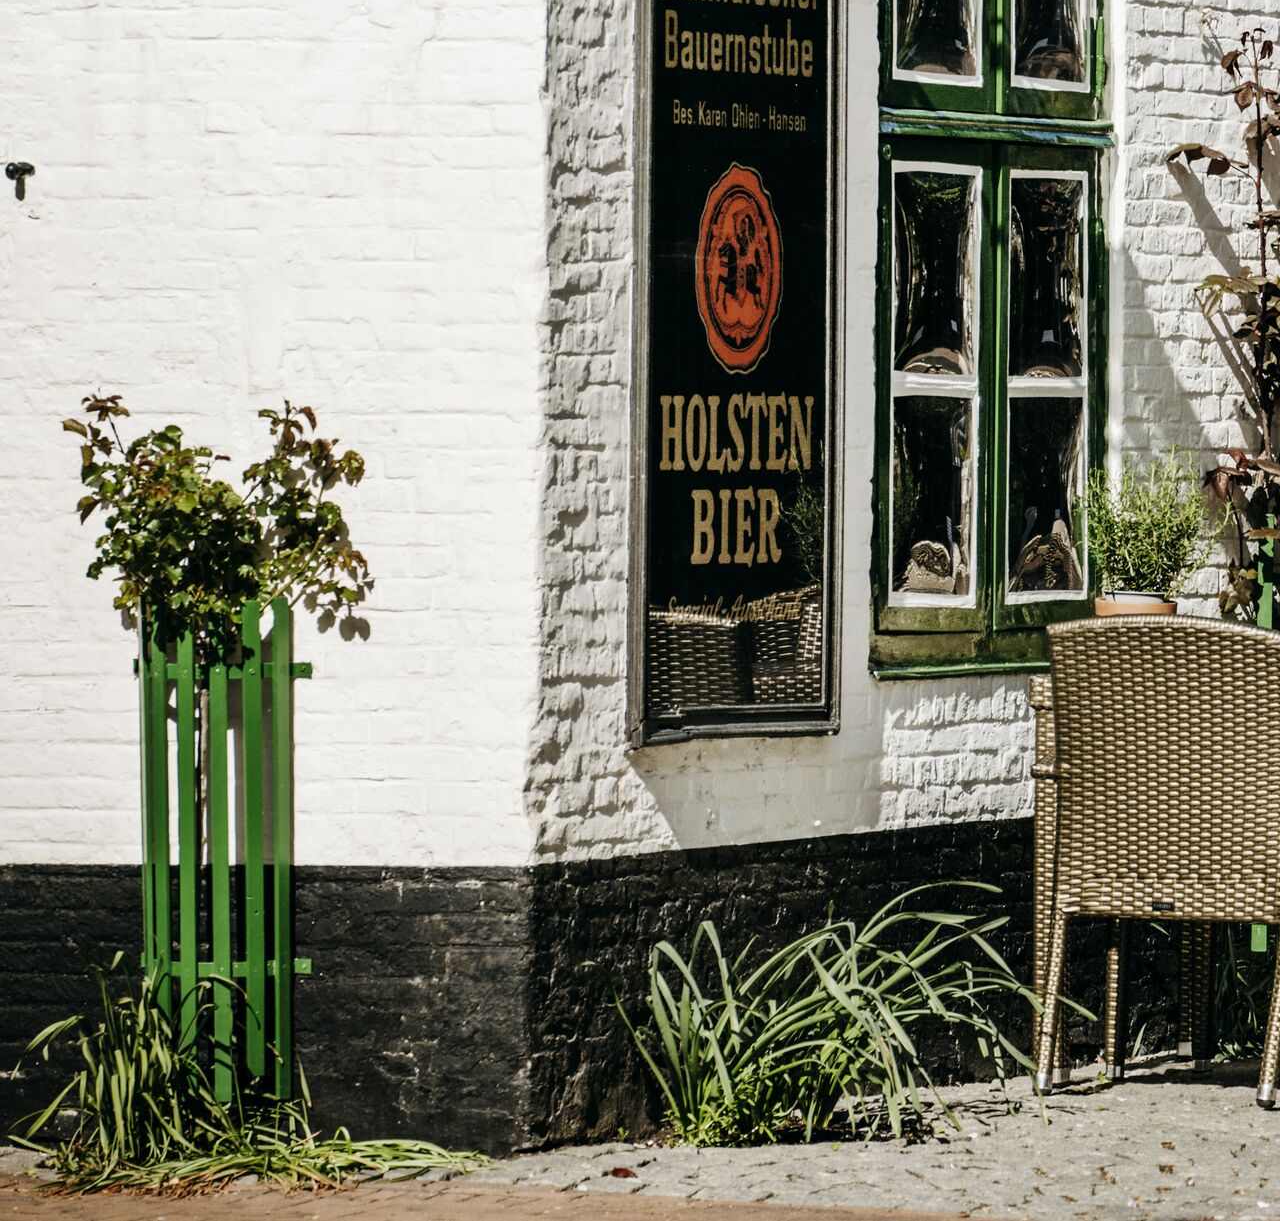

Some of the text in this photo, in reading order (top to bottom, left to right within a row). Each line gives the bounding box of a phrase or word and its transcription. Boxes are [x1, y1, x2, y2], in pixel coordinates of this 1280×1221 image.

[664, 9, 813, 77] Bauernstube
[673, 99, 696, 125] Bes.
[698, 101, 727, 127] Karen
[660, 392, 814, 472] HOLSTEN
[690, 486, 782, 567] BIER
